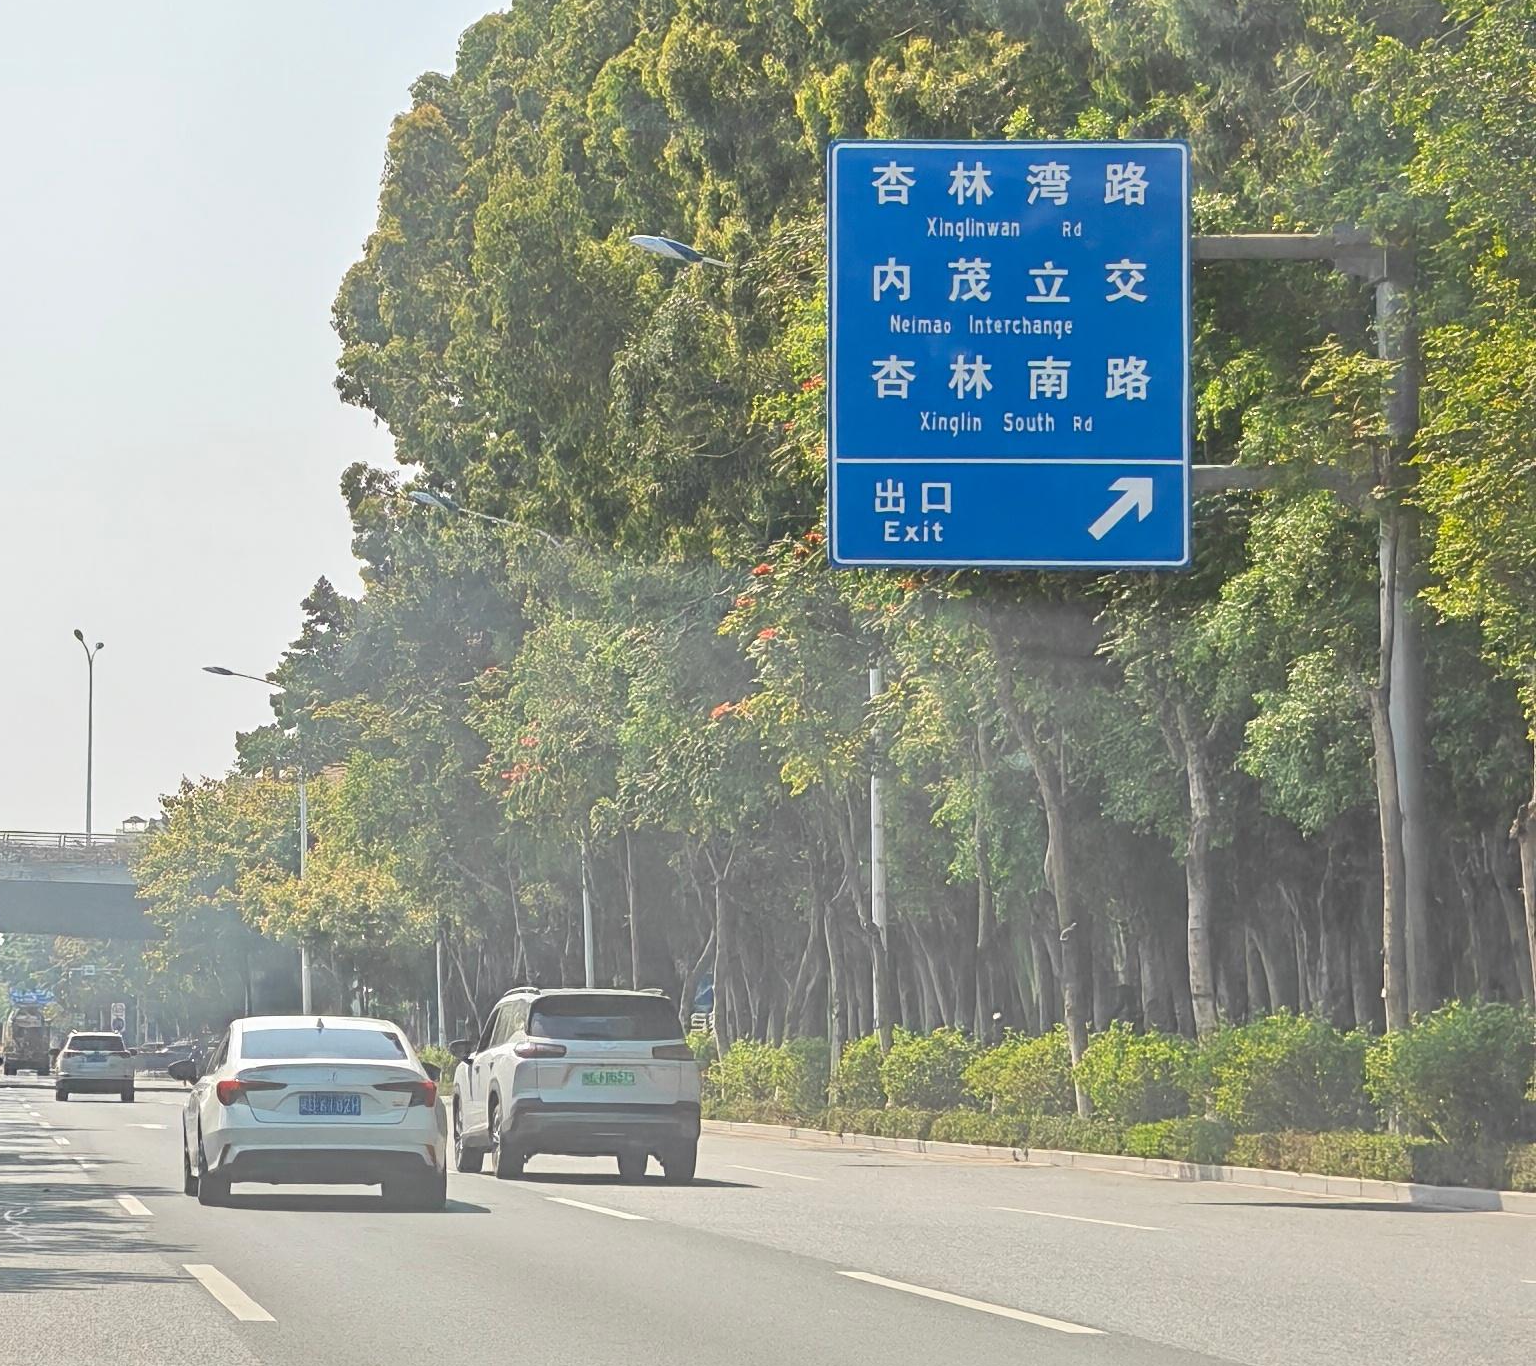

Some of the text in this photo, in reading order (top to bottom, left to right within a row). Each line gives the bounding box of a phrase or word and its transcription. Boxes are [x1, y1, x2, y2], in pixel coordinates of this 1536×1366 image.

[871, 160, 1151, 206] 杏林湾路
[926, 217, 1083, 242] Xinglinwan Rd
[872, 256, 1150, 304] 内茂立交
[890, 314, 1074, 340] Neimao Interchange
[871, 354, 1153, 402] 杏林南路
[920, 411, 1094, 437] Xinglin South Rd
[874, 478, 953, 515] 出口
[884, 520, 945, 543] Exit
